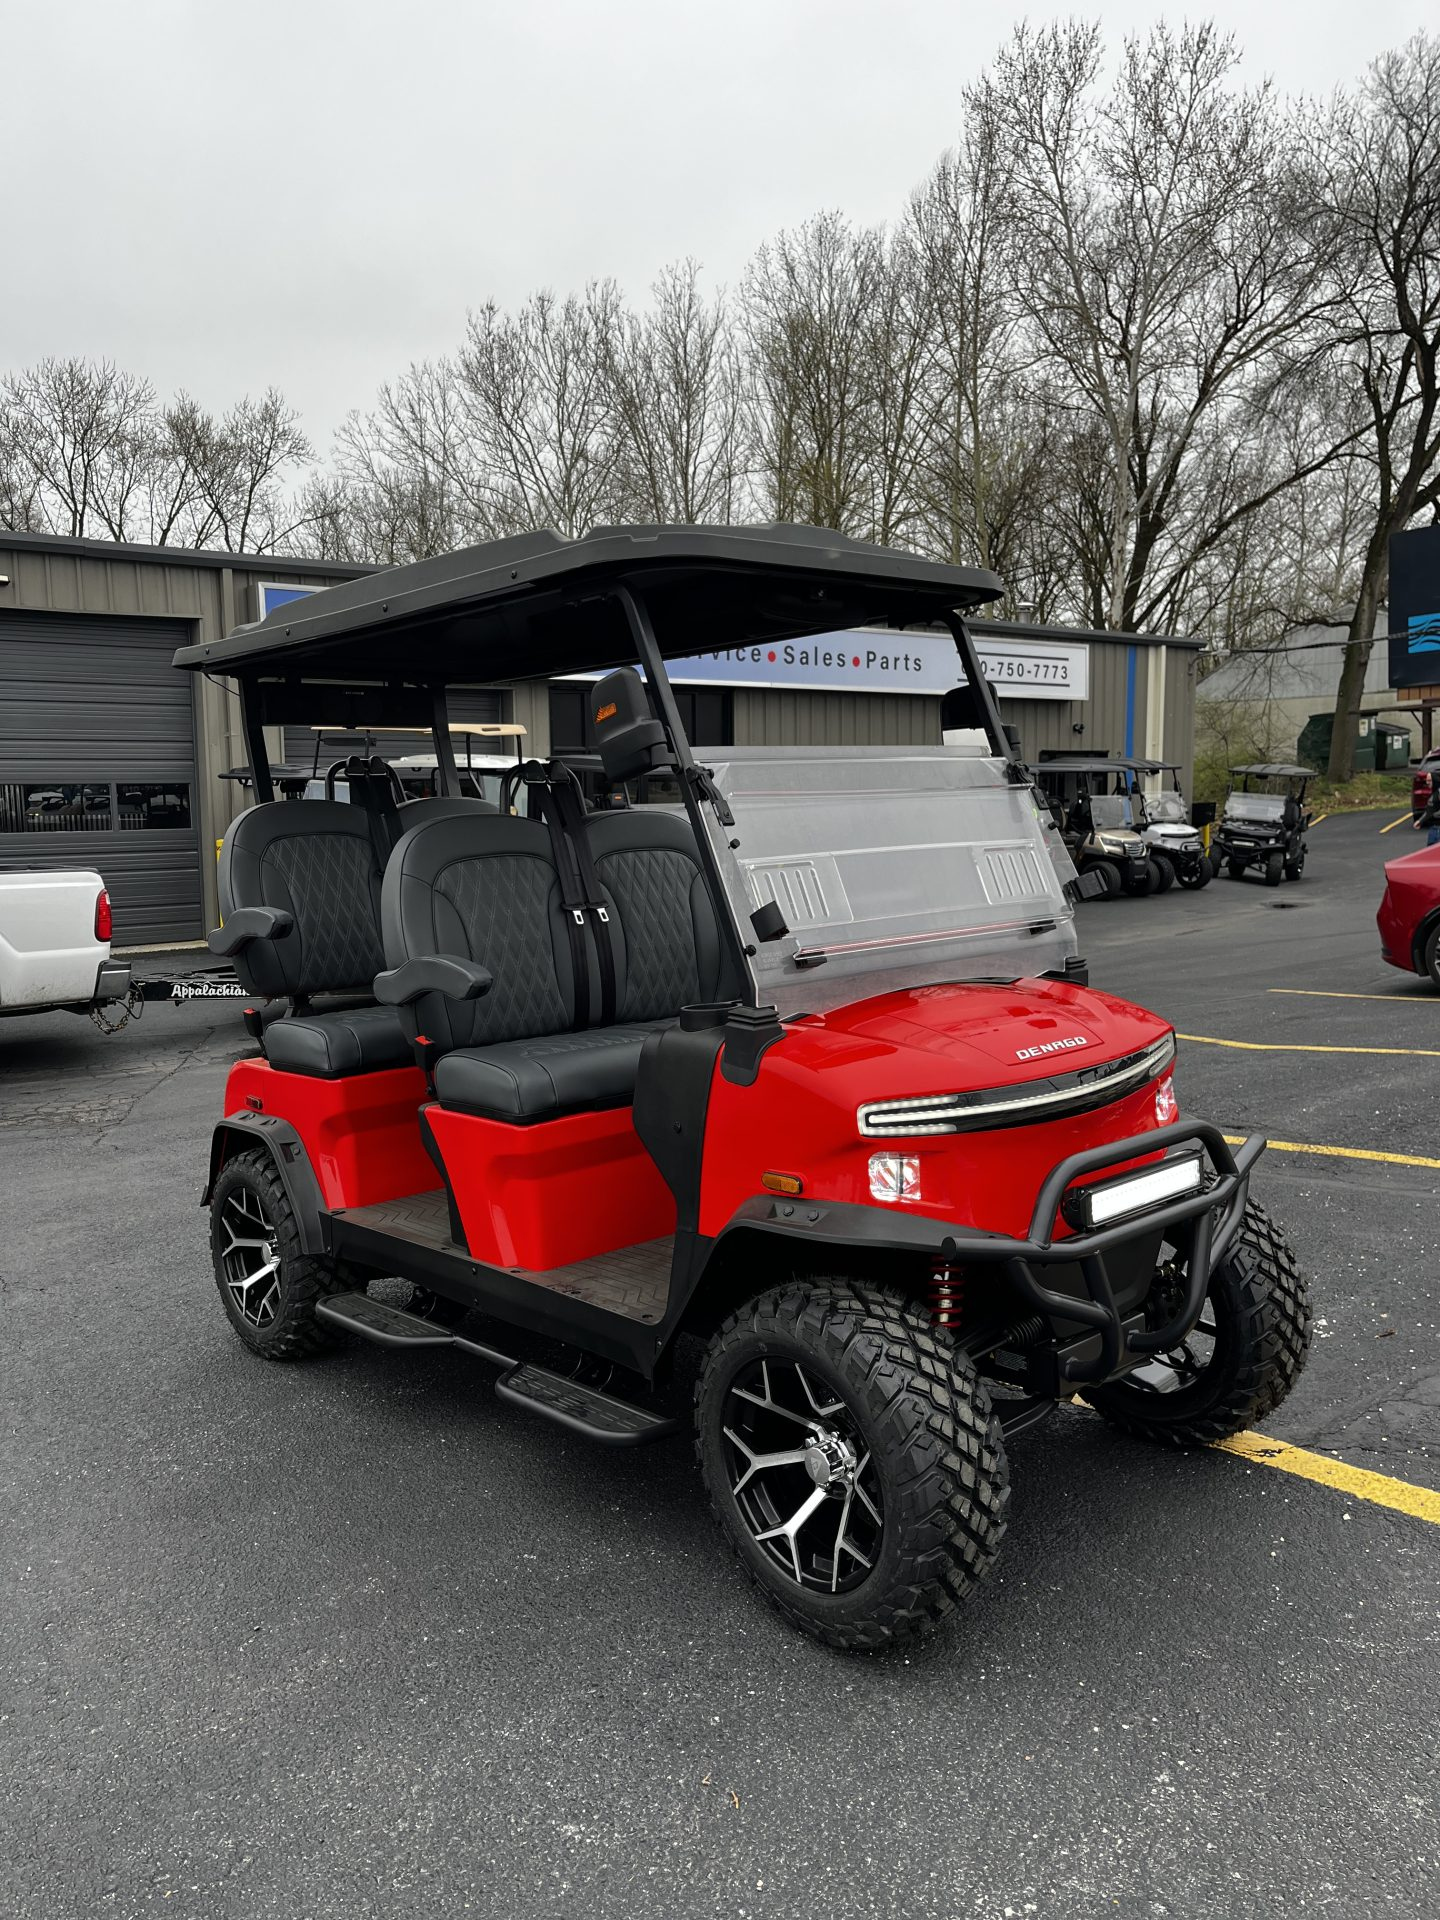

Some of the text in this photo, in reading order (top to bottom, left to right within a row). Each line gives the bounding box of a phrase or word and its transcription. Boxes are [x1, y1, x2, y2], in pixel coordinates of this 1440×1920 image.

[697, 645, 922, 672] vice Sales Parts
[961, 660, 1069, 680] 0-750-7773
[1015, 1036, 1088, 1061] DENAGO
